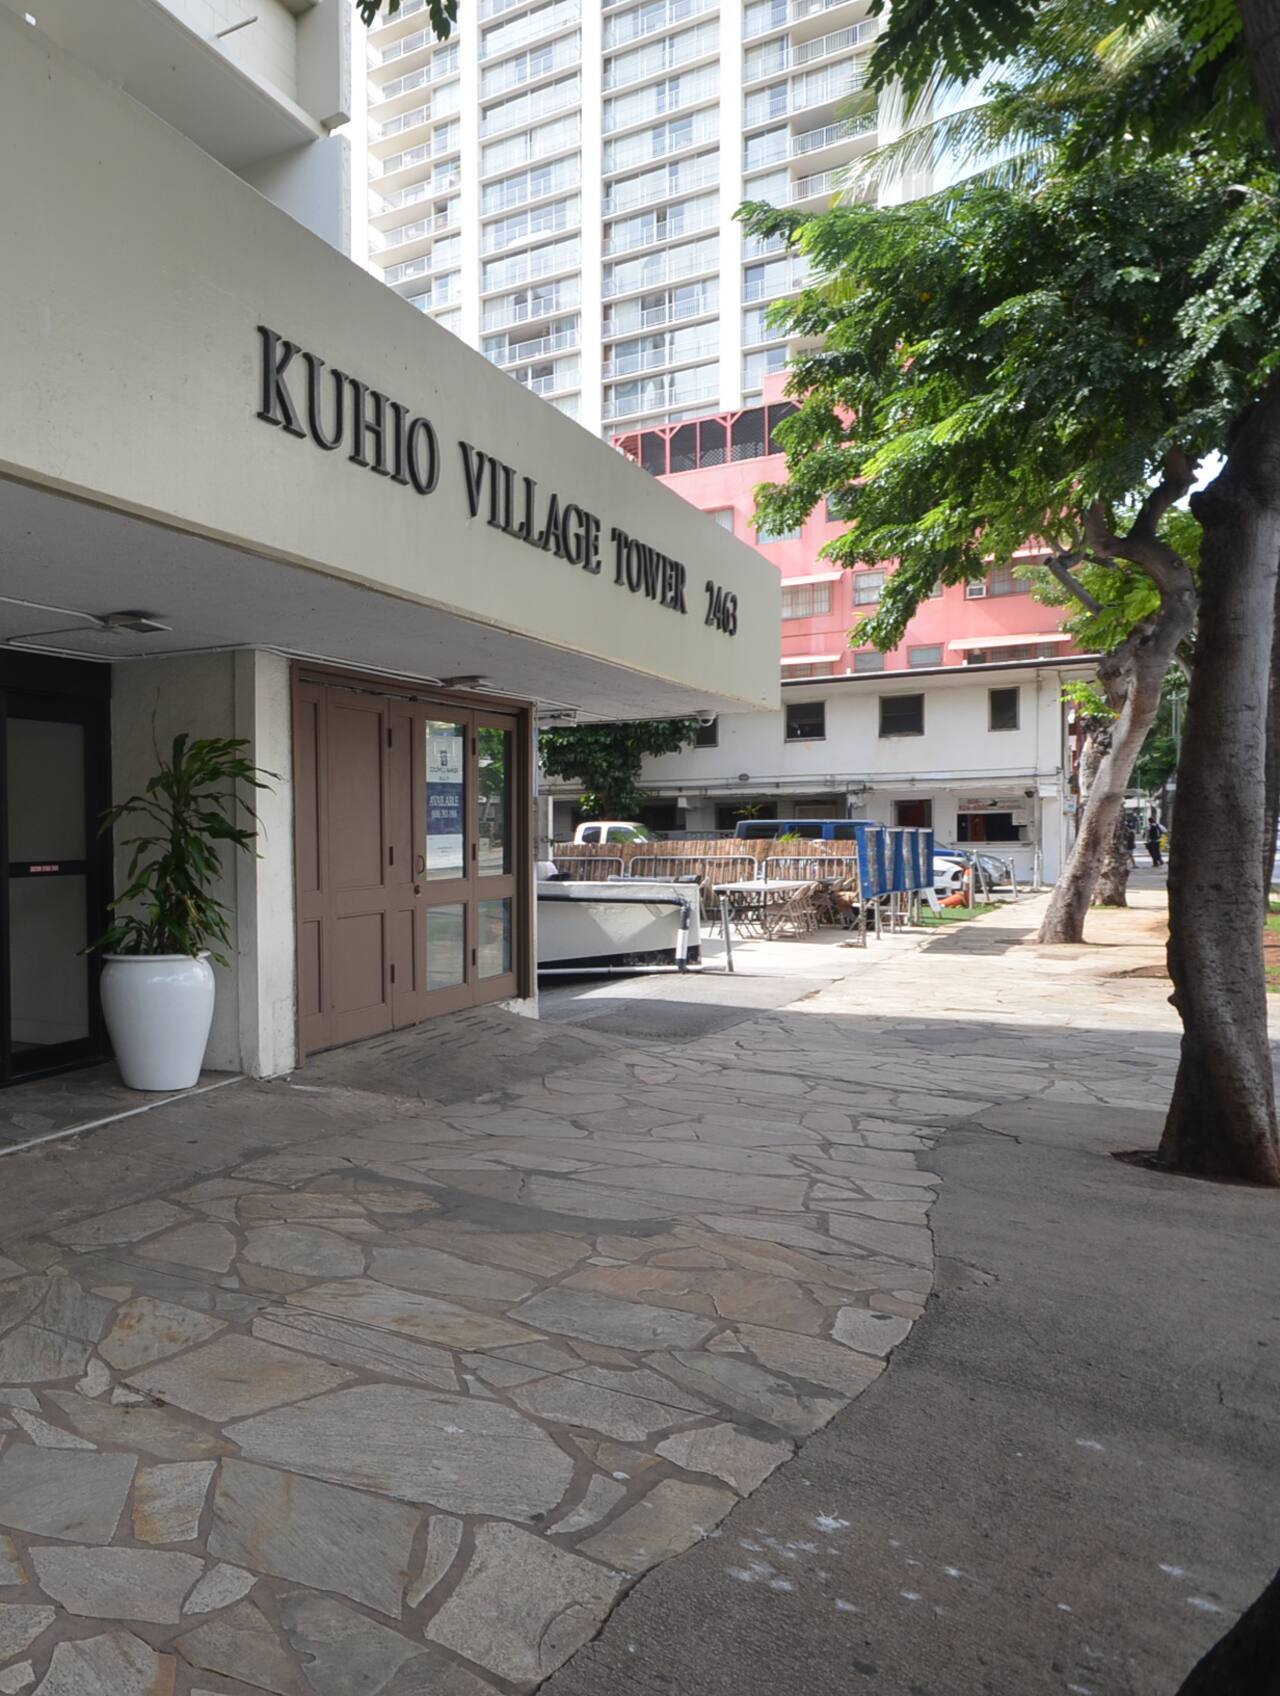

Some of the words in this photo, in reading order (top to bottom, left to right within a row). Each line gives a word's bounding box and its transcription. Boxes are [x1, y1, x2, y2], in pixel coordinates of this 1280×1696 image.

[256, 325, 440, 495] KUHIO
[458, 440, 602, 575] VILLAGE
[610, 526, 687, 614] TOWER
[704, 580, 737, 636] 2463
